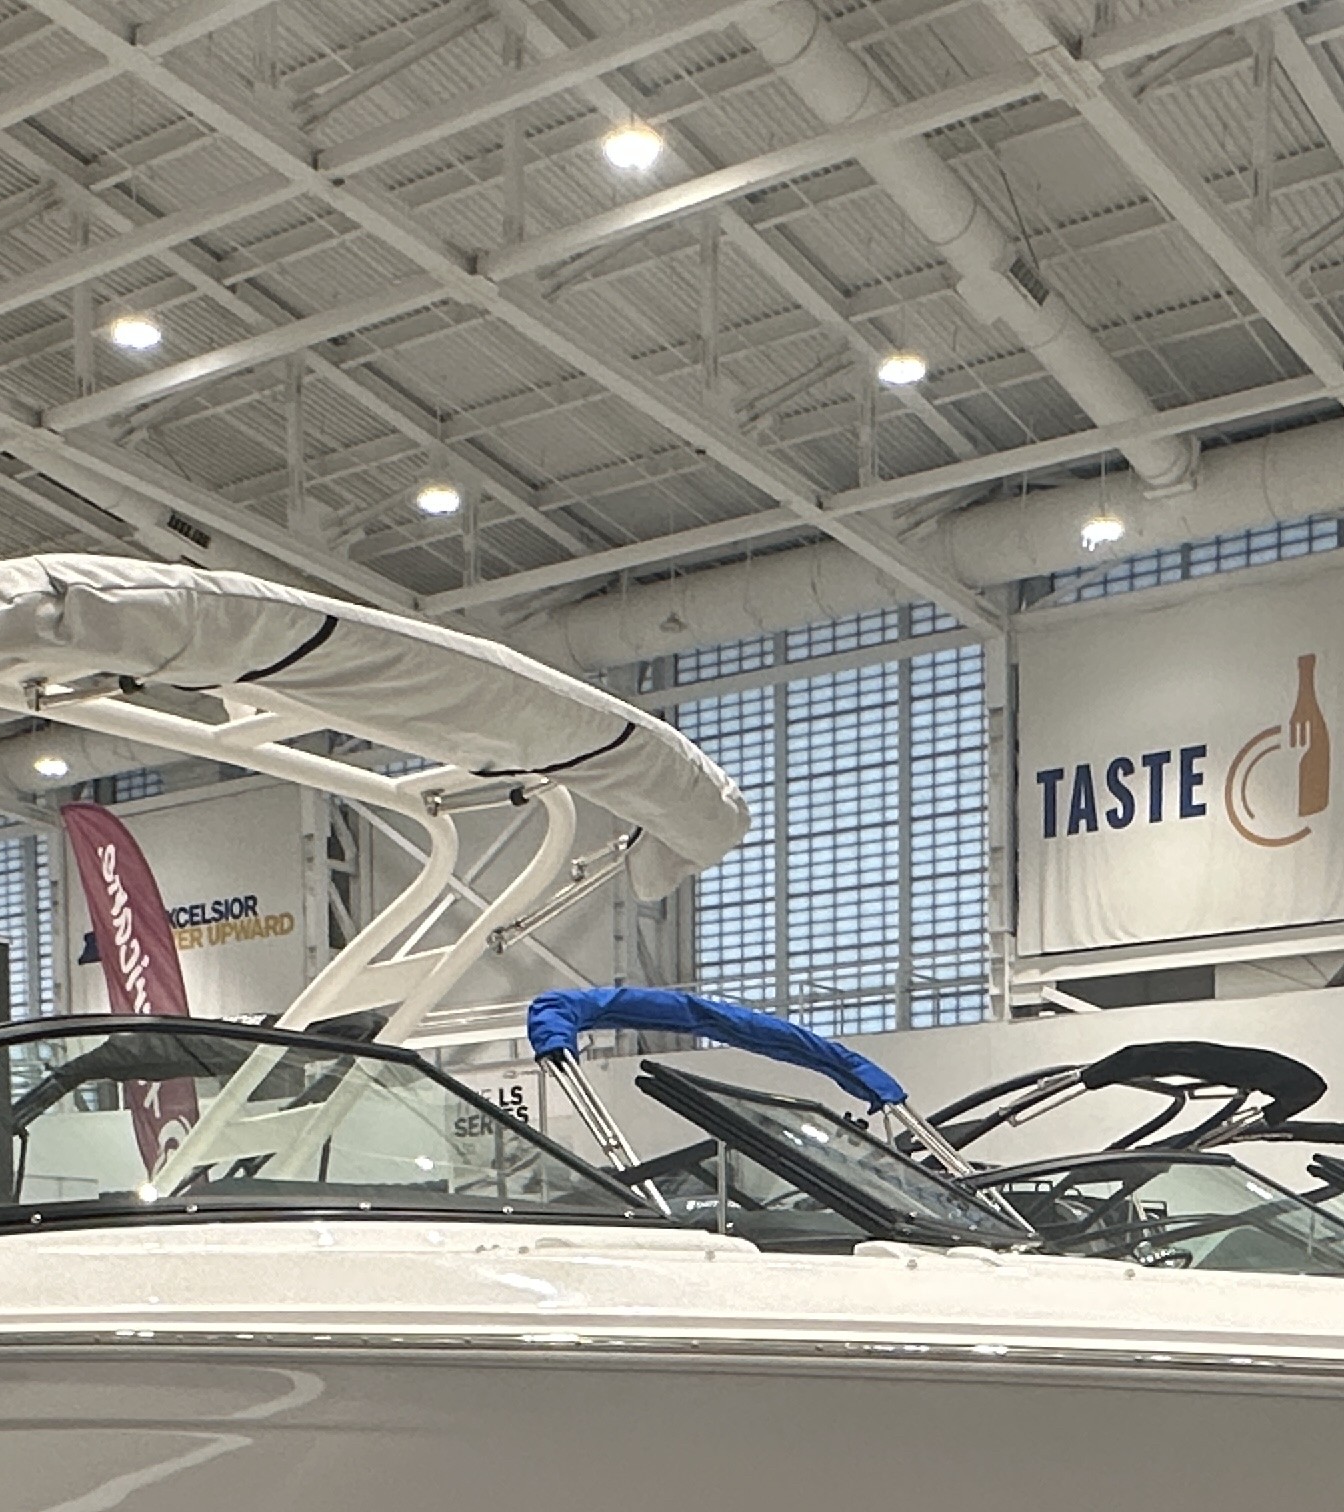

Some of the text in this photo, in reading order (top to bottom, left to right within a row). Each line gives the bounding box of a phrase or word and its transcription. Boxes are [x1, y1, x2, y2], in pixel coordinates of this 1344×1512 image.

[1036, 744, 1207, 839] TASTE
[166, 894, 258, 929] XCELSIOR
[173, 912, 295, 951] ER UPWARD
[498, 1085, 523, 1107] LS
[455, 1105, 529, 1138] SERS
